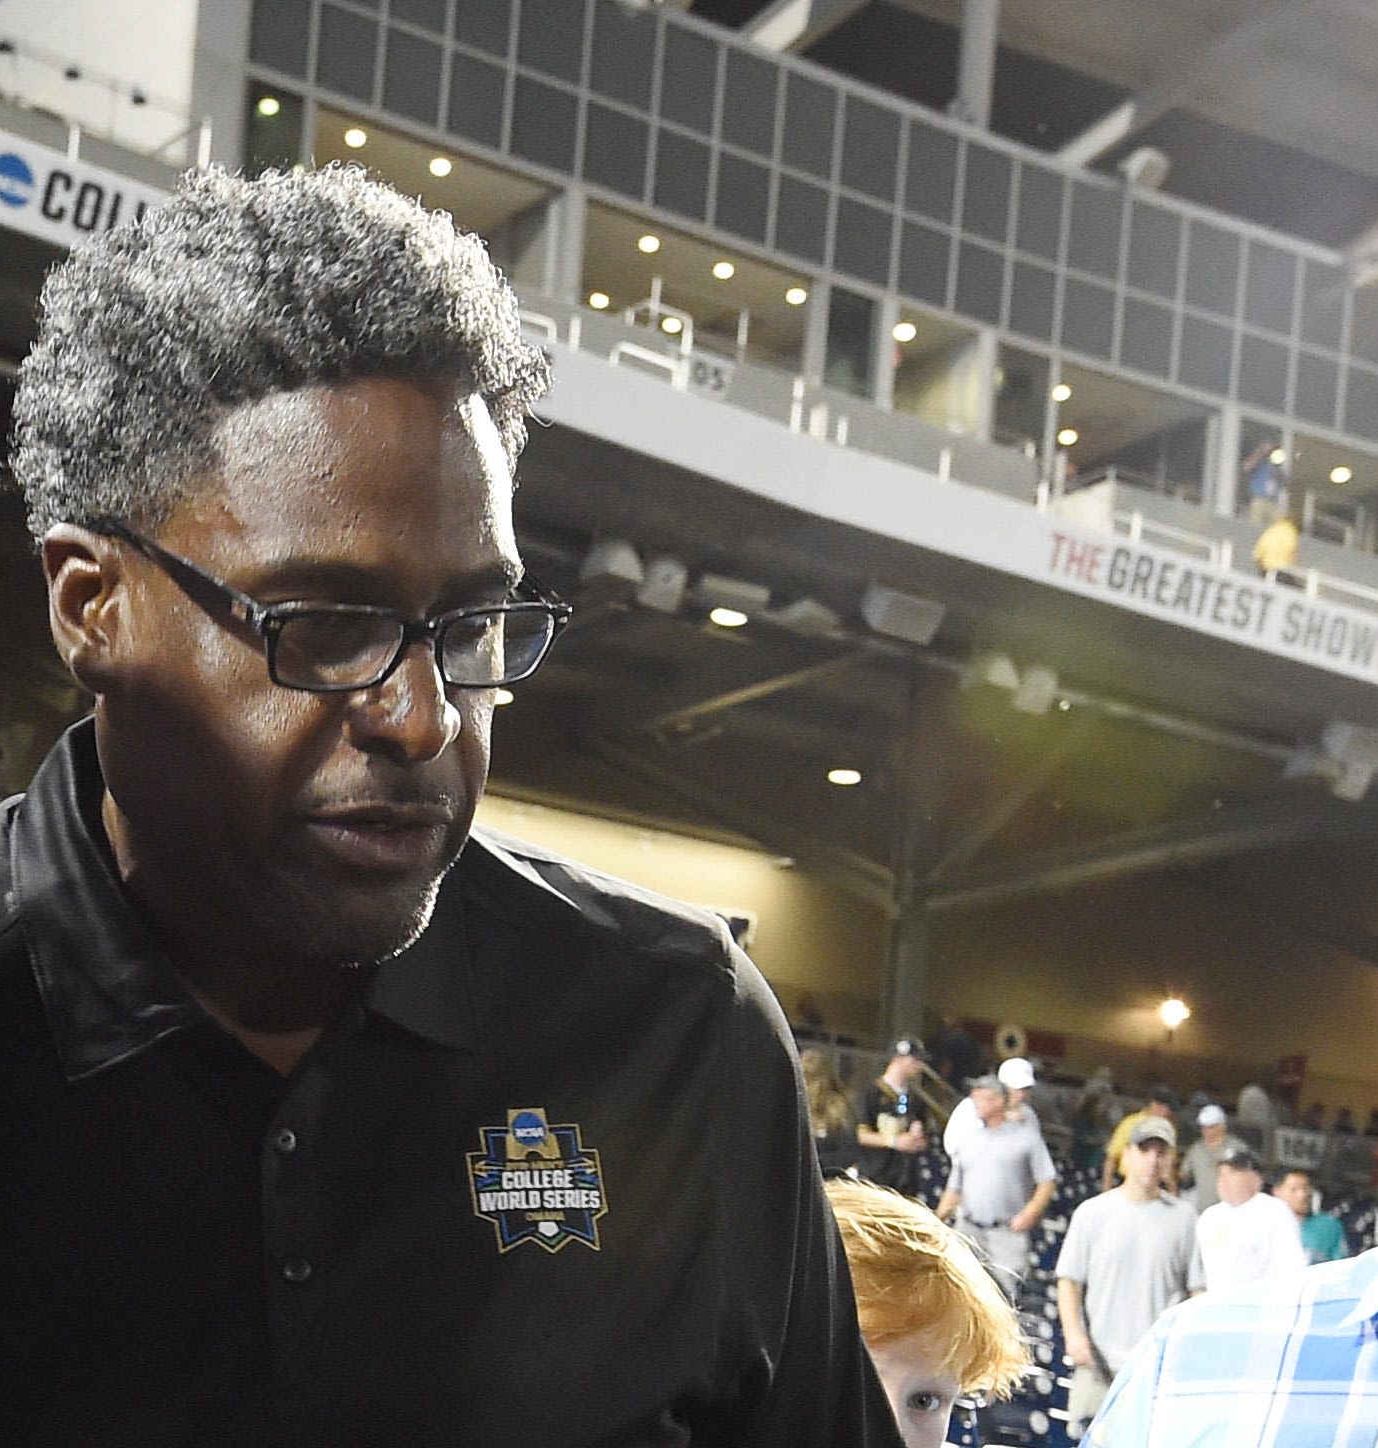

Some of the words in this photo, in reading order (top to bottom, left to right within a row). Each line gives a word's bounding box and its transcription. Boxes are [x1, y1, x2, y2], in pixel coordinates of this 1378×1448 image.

[1049, 531, 1103, 585] THE
[1107, 547, 1274, 637] GREATEST
[1279, 605, 1377, 666] SHOW
[501, 1169, 575, 1189] COLLEGE
[479, 1190, 541, 1212] WORLD
[542, 1189, 601, 1209] SERIES
